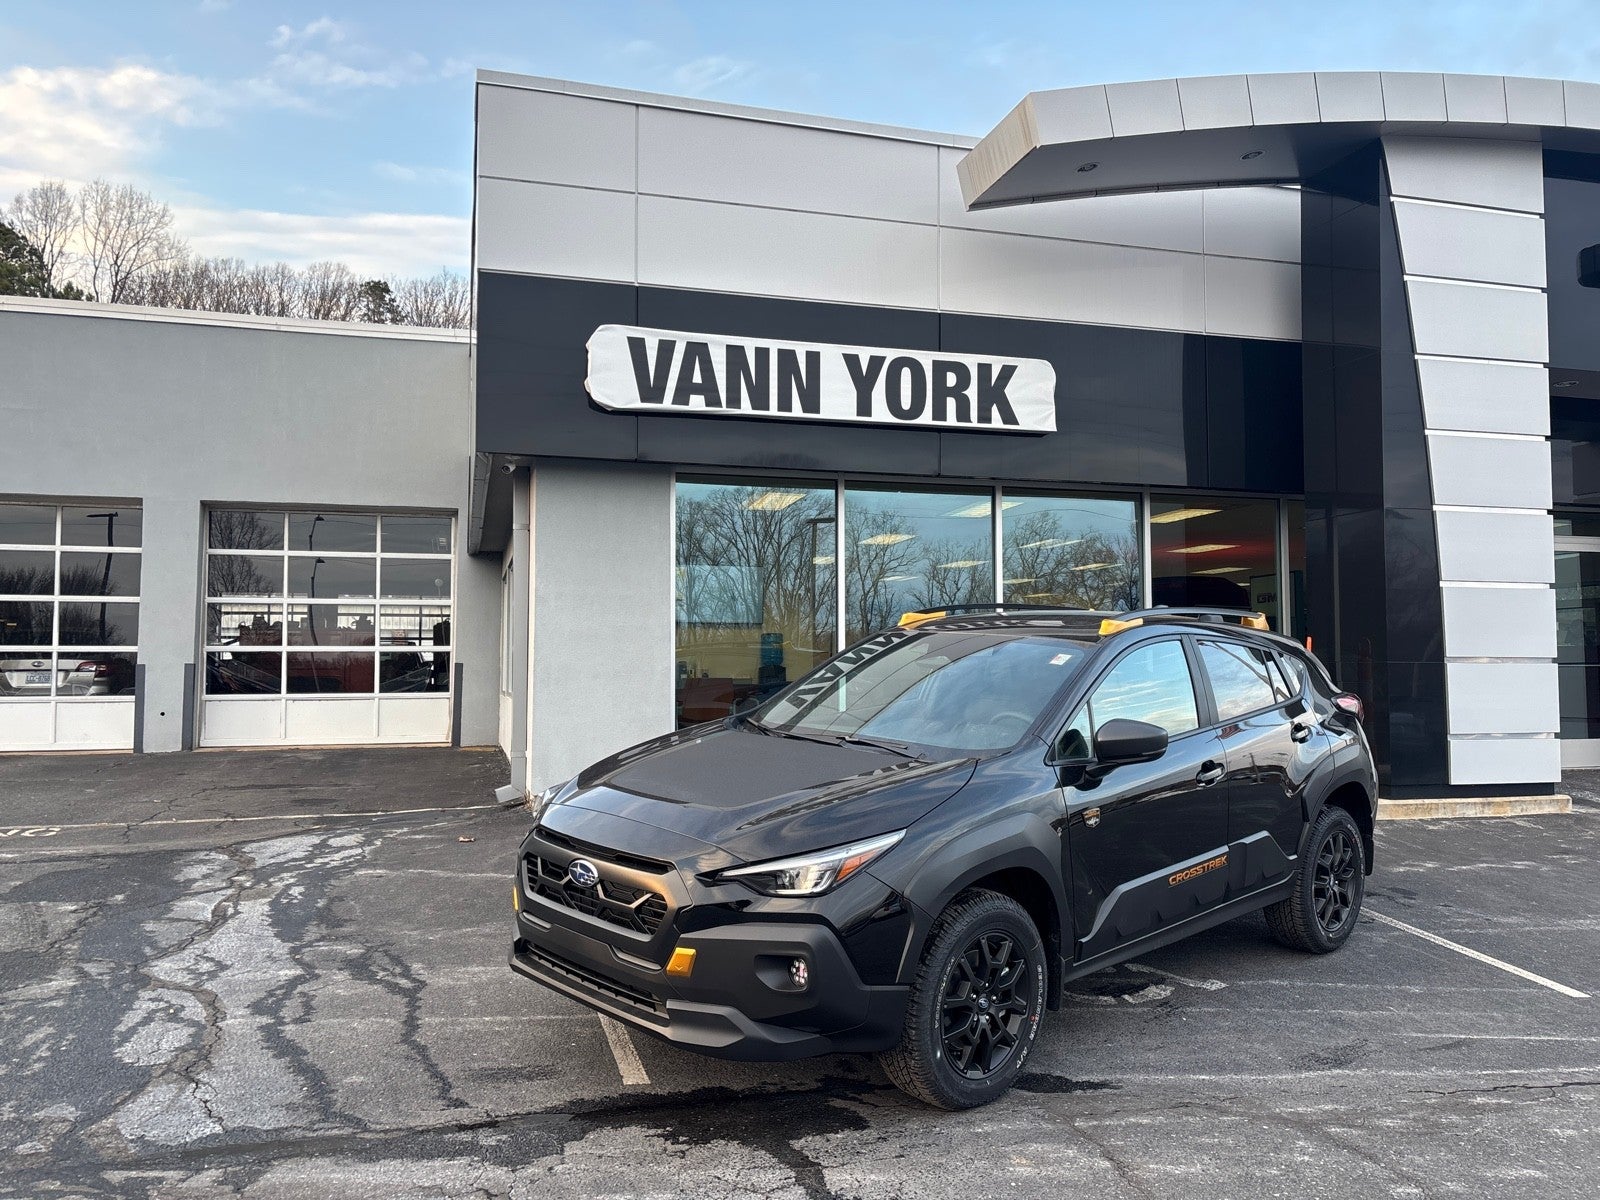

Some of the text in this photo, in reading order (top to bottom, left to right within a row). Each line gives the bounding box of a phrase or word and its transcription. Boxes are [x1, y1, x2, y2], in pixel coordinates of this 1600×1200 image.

[626, 336, 1020, 426] VANN YORK
[1168, 855, 1228, 886] CROSSTREK
